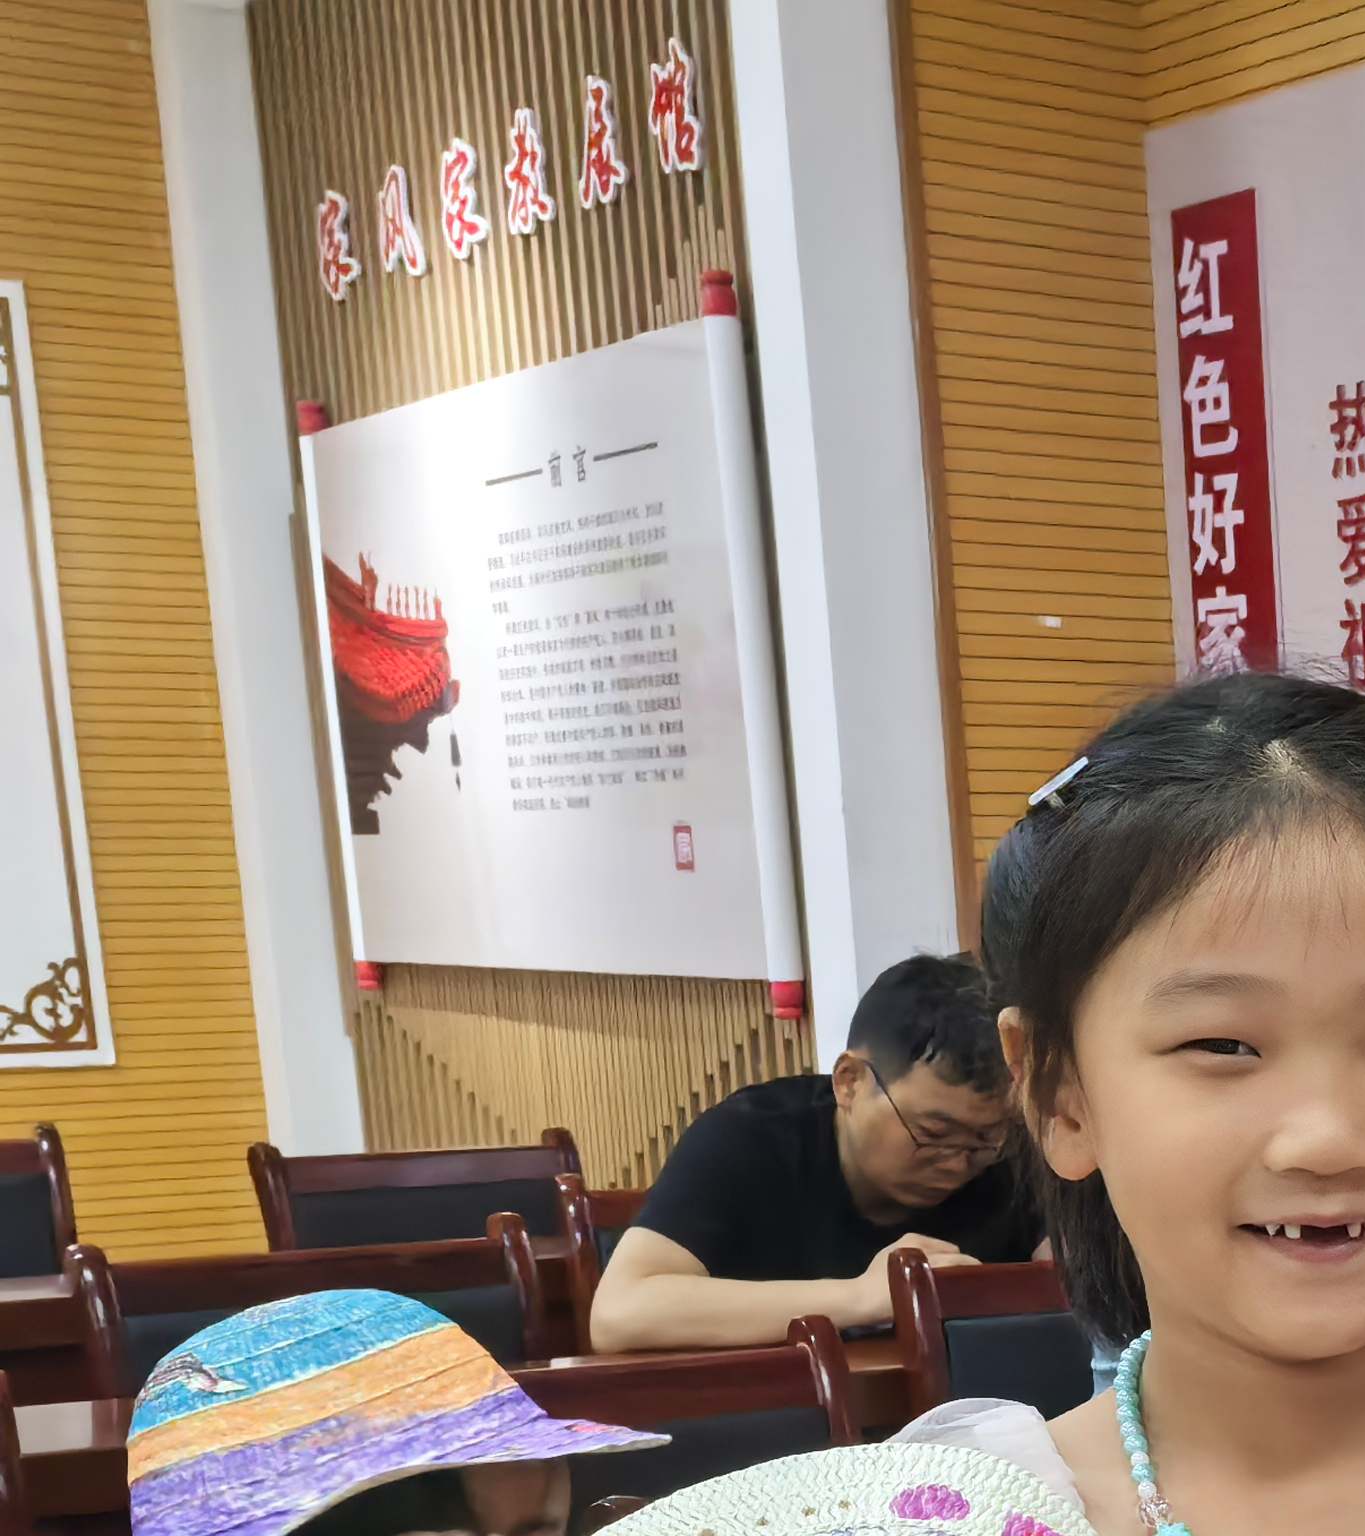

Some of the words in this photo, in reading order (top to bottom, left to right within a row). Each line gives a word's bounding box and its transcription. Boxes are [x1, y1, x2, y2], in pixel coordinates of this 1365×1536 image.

[316, 37, 703, 301] 家风家教展馆
